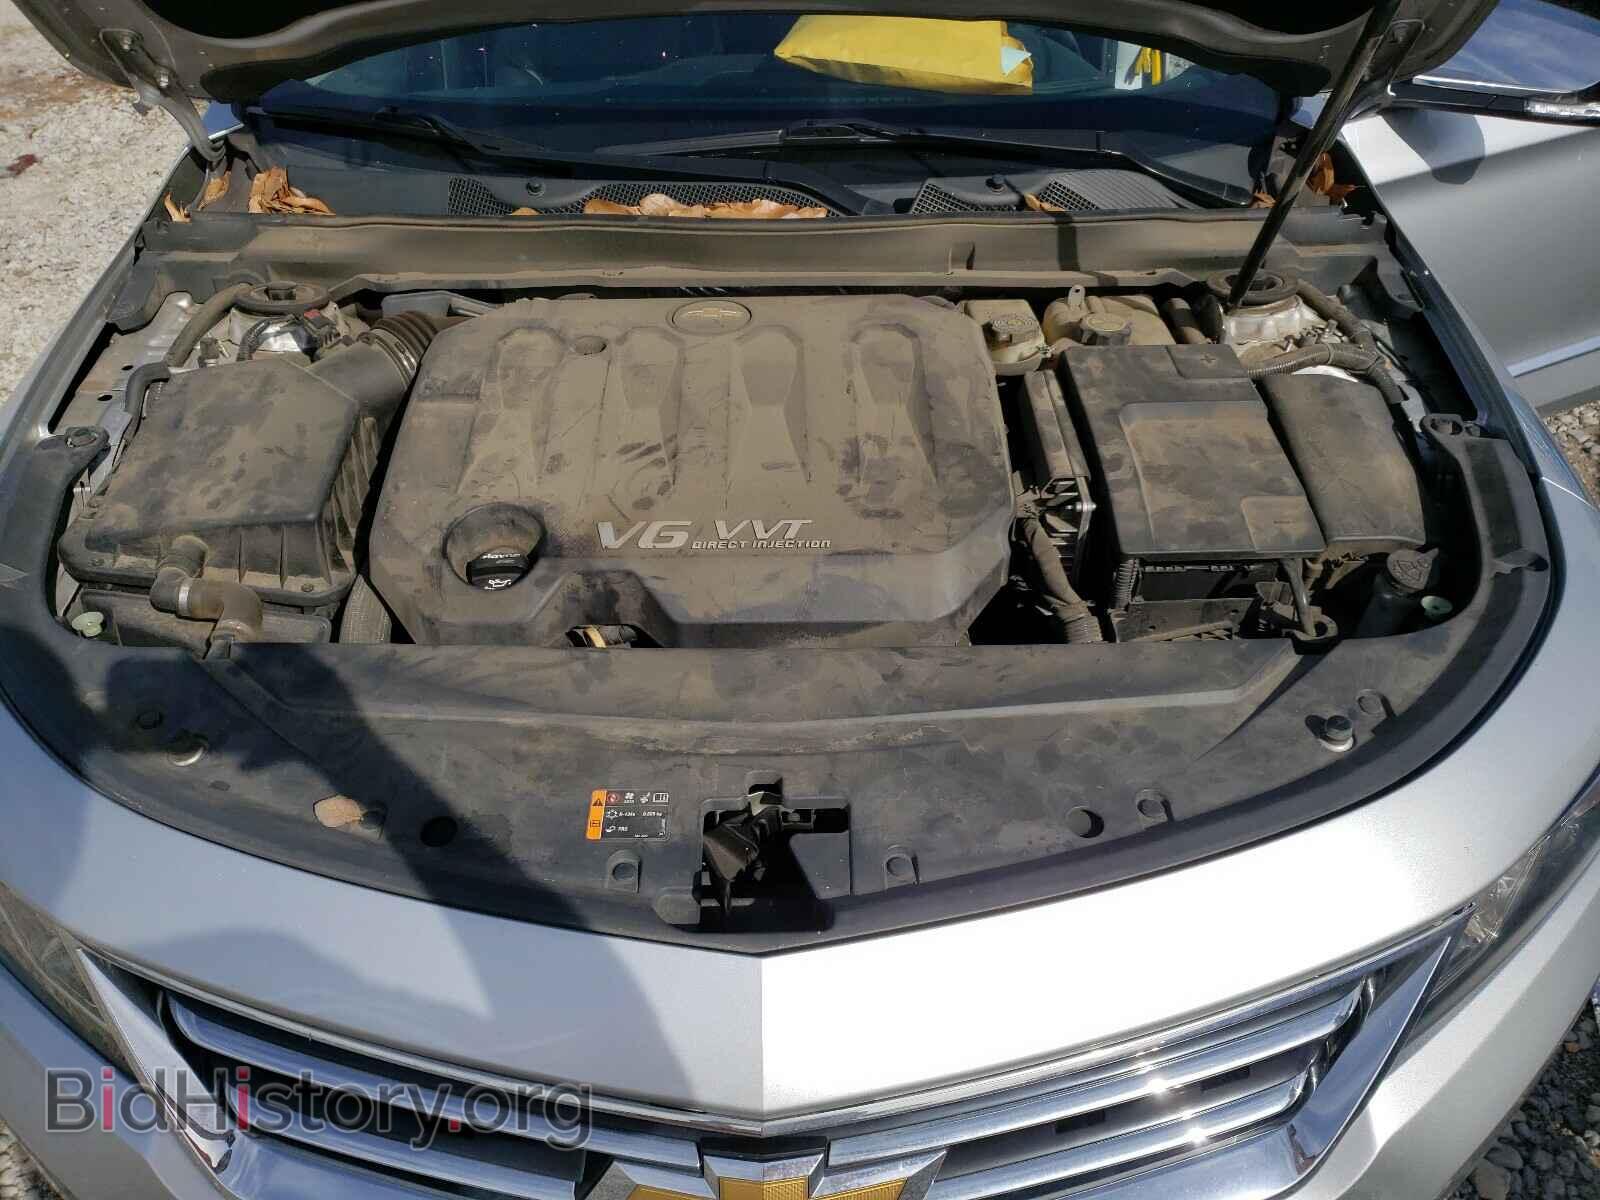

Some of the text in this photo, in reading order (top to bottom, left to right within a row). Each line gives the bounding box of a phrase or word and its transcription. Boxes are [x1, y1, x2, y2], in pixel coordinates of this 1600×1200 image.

[597, 519, 813, 550] V6 VVT
[691, 539, 748, 550] DIRECT
